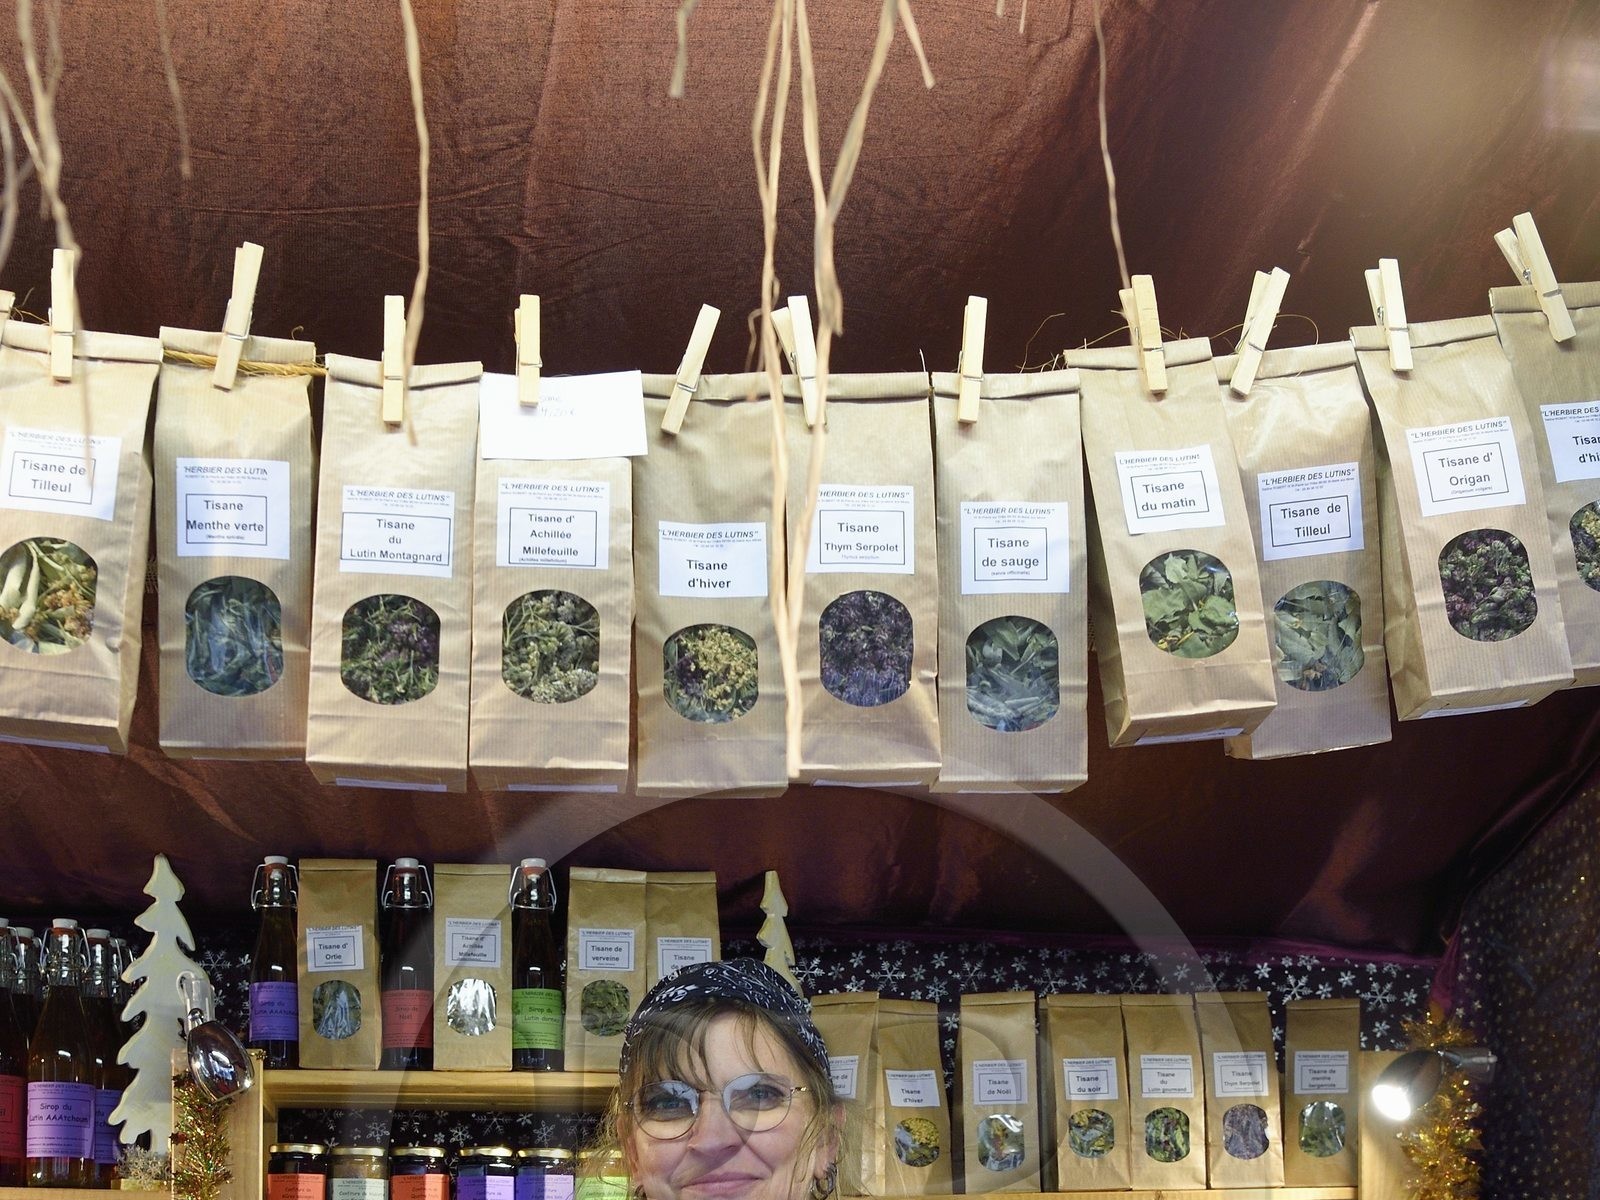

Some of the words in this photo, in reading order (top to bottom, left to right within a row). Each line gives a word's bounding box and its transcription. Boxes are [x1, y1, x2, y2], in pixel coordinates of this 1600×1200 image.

[1583, 406, 1600, 415] DES
[1456, 425, 1474, 435] DES
[1438, 453, 1478, 469] Tisane
[21, 459, 65, 476] Tisane
[68, 464, 87, 476] de
[1306, 472, 1323, 482] DES
[1449, 472, 1491, 487] Origan
[31, 478, 72, 493] Tilleul
[546, 484, 564, 492] DES
[1142, 481, 1185, 494] Tisane
[204, 499, 244, 511] Tisane
[1141, 501, 1158, 512] du
[1161, 497, 1196, 510] matin
[1280, 505, 1320, 519] Tisane
[1326, 502, 1341, 514] de
[1007, 507, 1025, 515] DES
[376, 518, 416, 531] Tisane
[528, 513, 562, 524] Tisane
[186, 519, 230, 532] Menthe
[233, 522, 264, 533] verte
[837, 522, 880, 534] Tisane
[1294, 523, 1331, 538] Tilleul
[388, 535, 402, 545] du
[530, 528, 572, 540] Achillée
[824, 542, 853, 554] Thym
[855, 542, 899, 554] Serpolet
[987, 537, 1030, 548] Tisane
[350, 548, 378, 559] Lutin
[379, 550, 442, 564] Montagnard
[522, 545, 579, 558] Millefeuille
[686, 559, 728, 571] Tisane
[981, 556, 998, 567] de
[1001, 557, 1040, 569] sauge
[688, 577, 732, 590] d'hiver
[590, 944, 612, 953] Tisane
[613, 945, 623, 953] de
[325, 952, 343, 961] Ortie
[591, 955, 620, 964] verveine
[673, 953, 695, 962] Tisane
[987, 1088, 996, 1096] de
[996, 1087, 1012, 1096] Noël
[1088, 1085, 1102, 1093] soir
